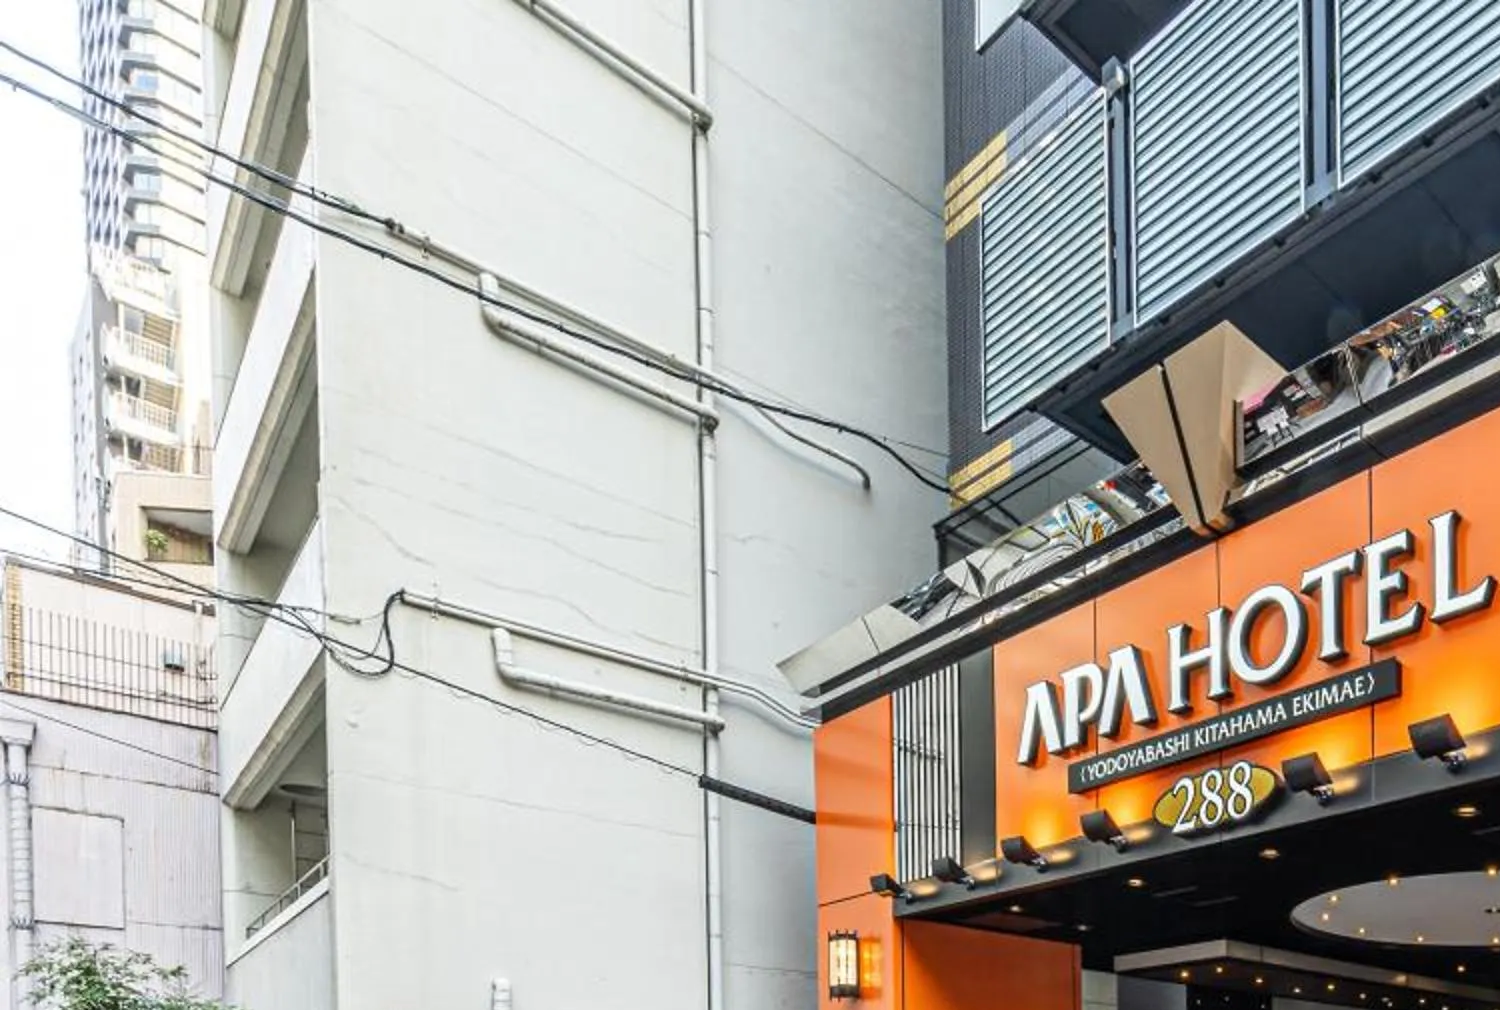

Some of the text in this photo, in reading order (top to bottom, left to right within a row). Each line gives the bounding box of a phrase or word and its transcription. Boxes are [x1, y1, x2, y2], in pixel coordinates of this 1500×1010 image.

[1017, 509, 1498, 765] APA HOTEL
[1194, 702, 1287, 747] KITAHAMA
[1171, 760, 1255, 835] 288
